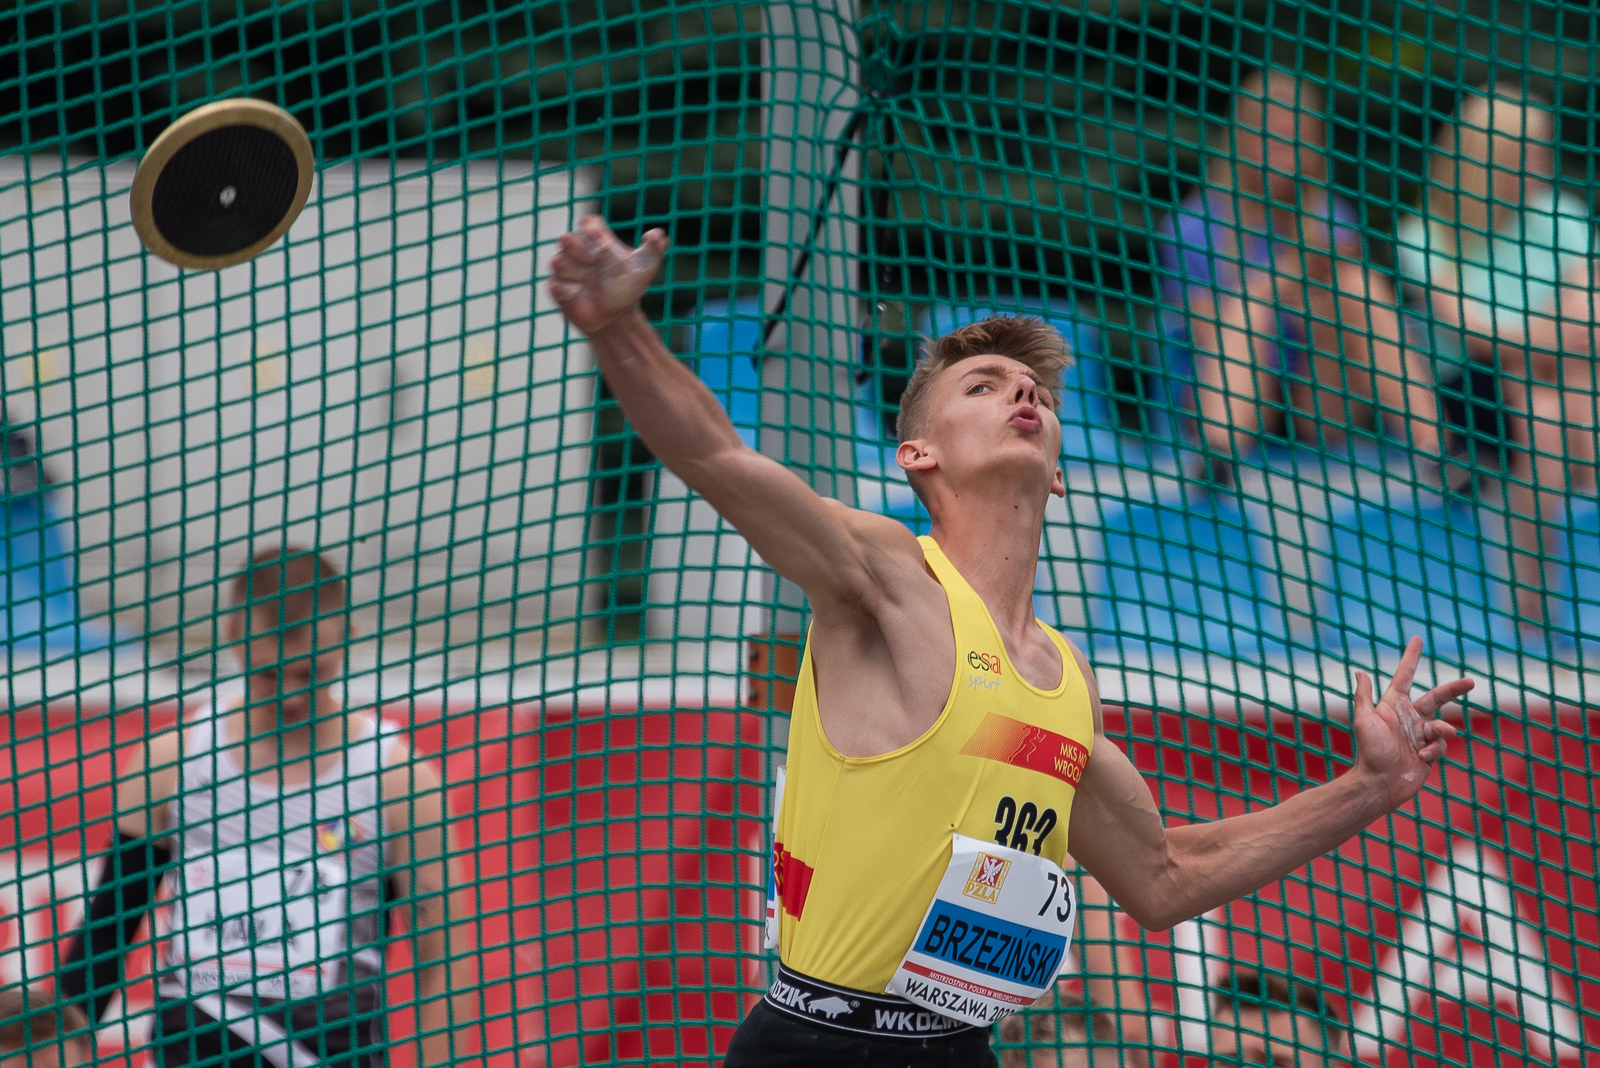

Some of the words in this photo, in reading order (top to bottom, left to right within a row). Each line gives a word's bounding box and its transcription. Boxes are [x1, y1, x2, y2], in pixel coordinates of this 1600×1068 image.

[967, 650, 1002, 675] esa
[1059, 741, 1078, 762] MKS
[964, 881, 996, 902] PZLA
[1037, 872, 1072, 923] 73
[922, 914, 1061, 986] BRZEZIŃSKI
[769, 979, 812, 1012] DZIK
[904, 977, 988, 1021] WARSZAWA
